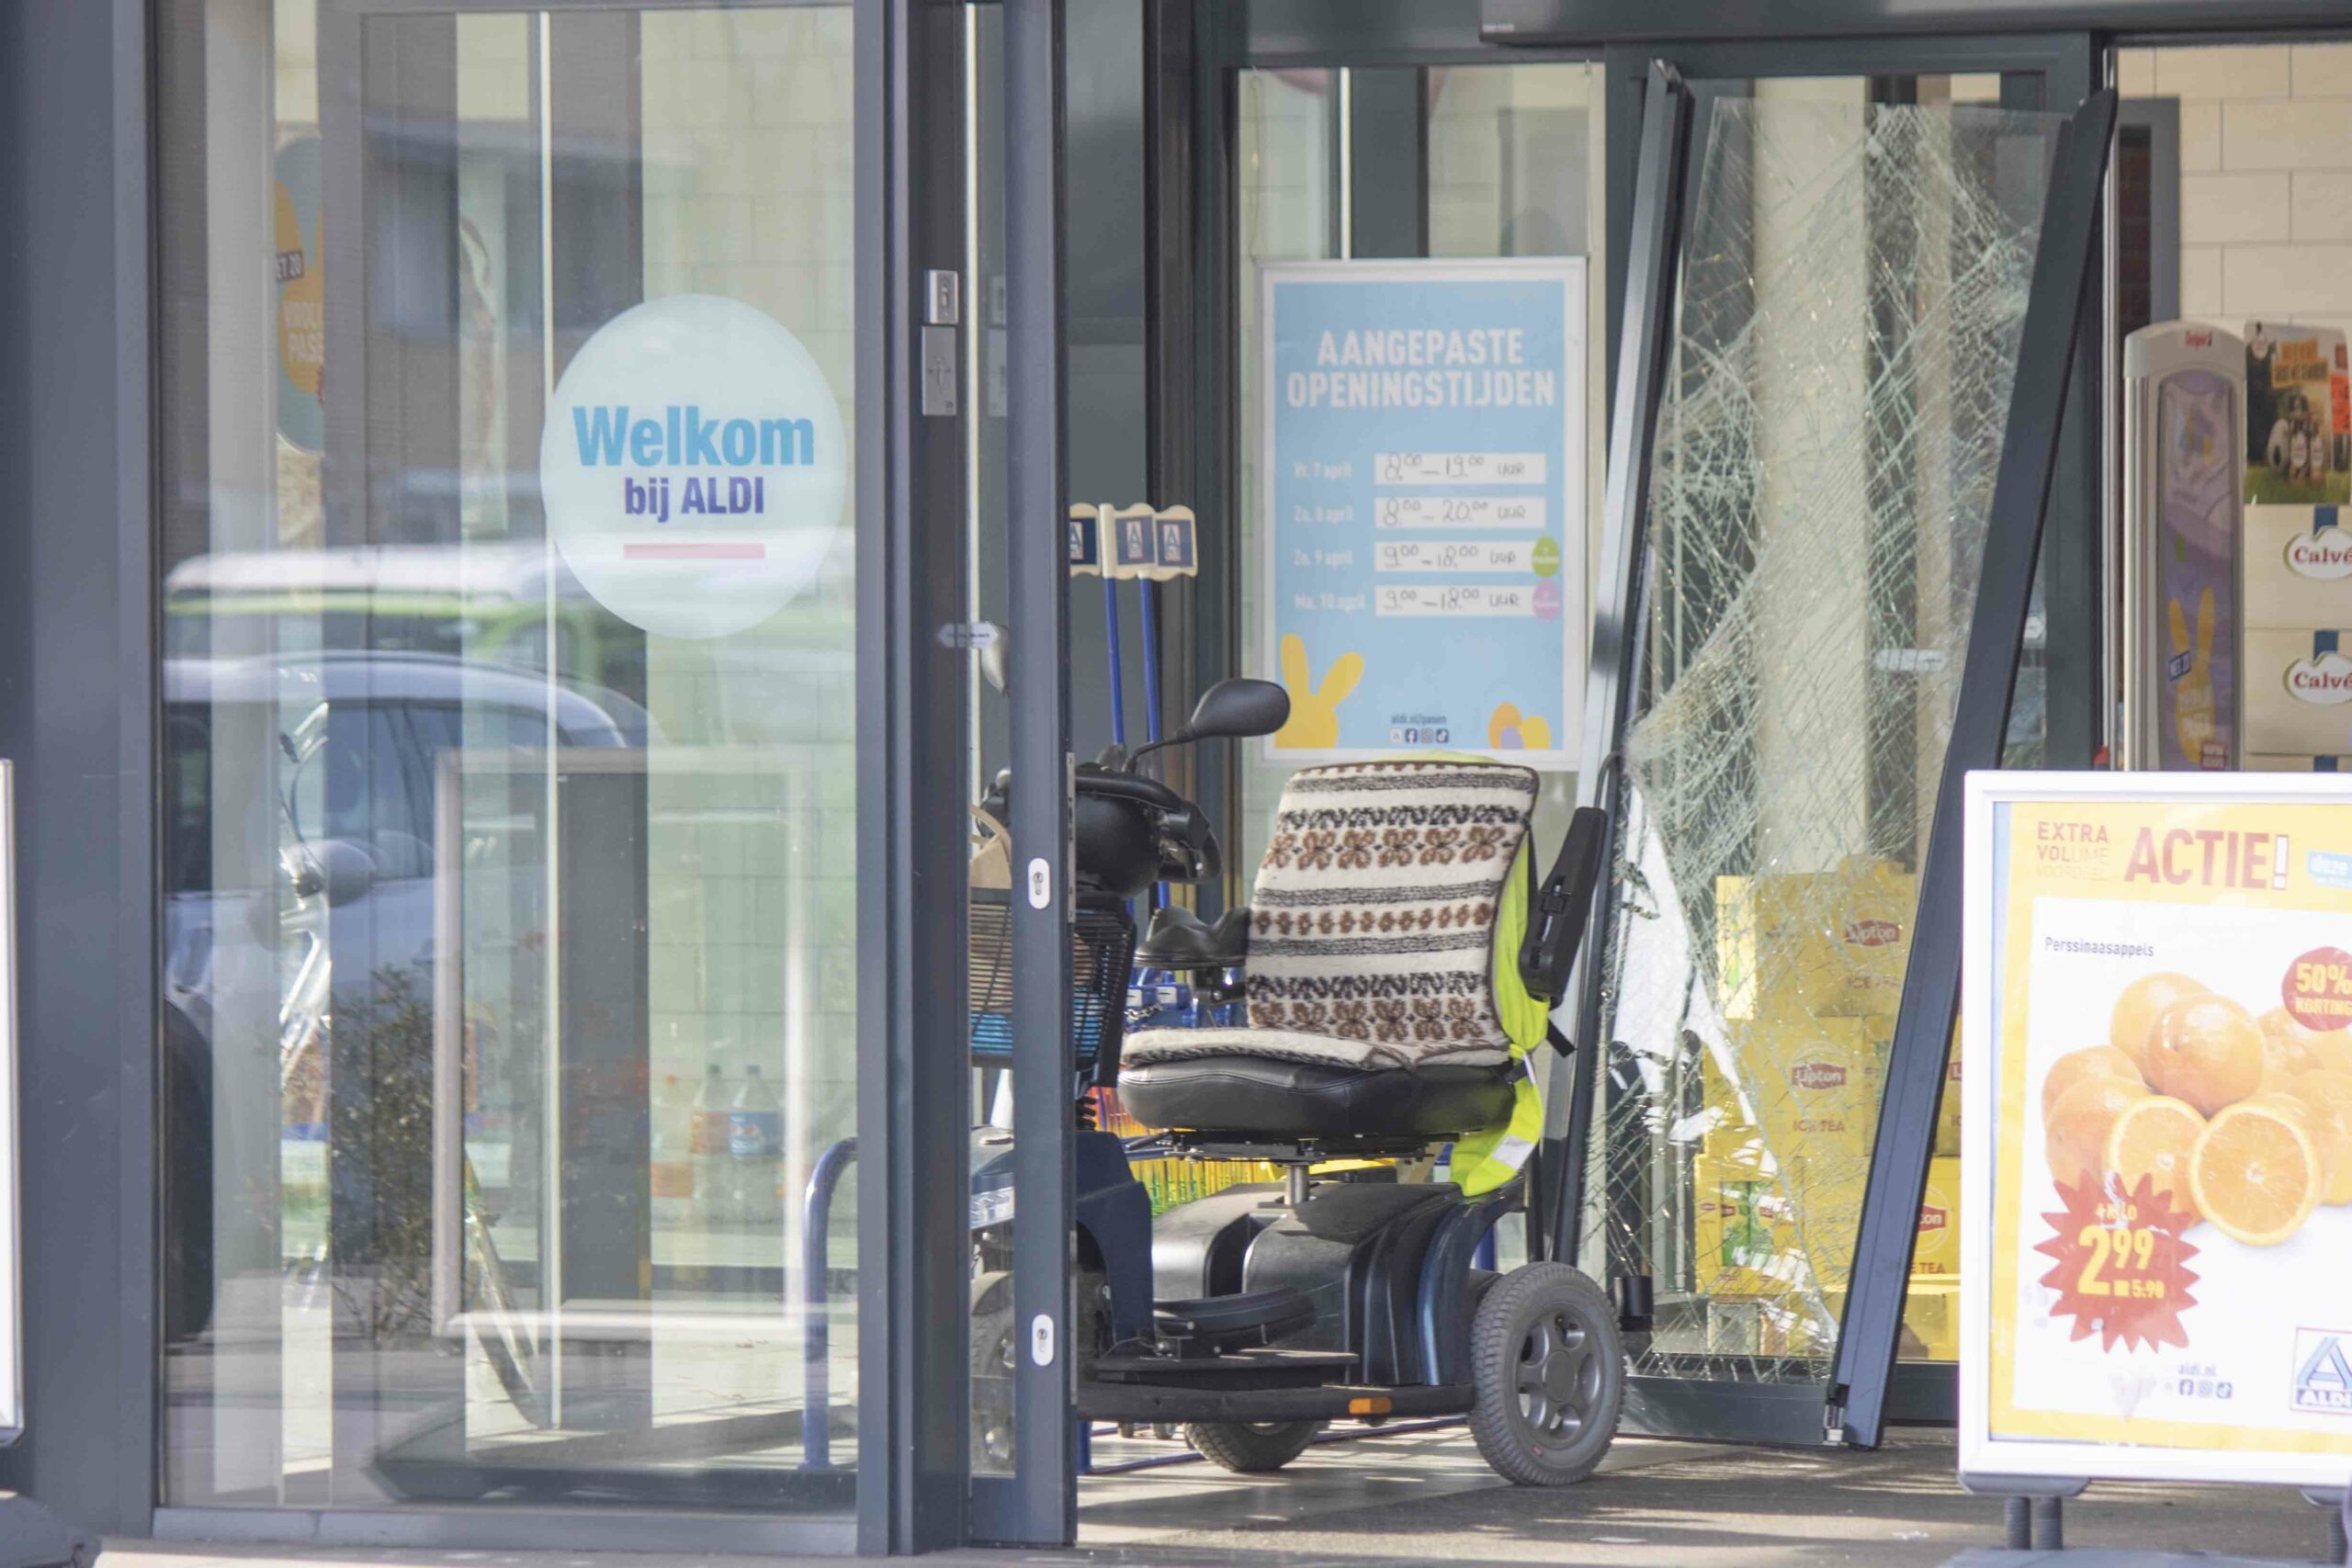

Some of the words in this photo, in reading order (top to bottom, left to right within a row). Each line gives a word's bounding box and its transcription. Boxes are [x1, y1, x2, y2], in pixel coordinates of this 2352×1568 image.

[1317, 328, 1524, 367] AANGEPASTE
[1287, 369, 1555, 408] OPENINGSTIJDEN
[572, 405, 815, 467] Welkom
[624, 477, 670, 524] bij
[680, 476, 764, 515] ALDI
[2037, 821, 2109, 843] EXTRA
[2036, 844, 2109, 864] VOLUME
[2124, 826, 2290, 890] ACTIE!
[2044, 936, 2155, 959] Perssinaasappels
[2295, 962, 2352, 995] 50%
[1919, 1262, 1946, 1274] TEA
